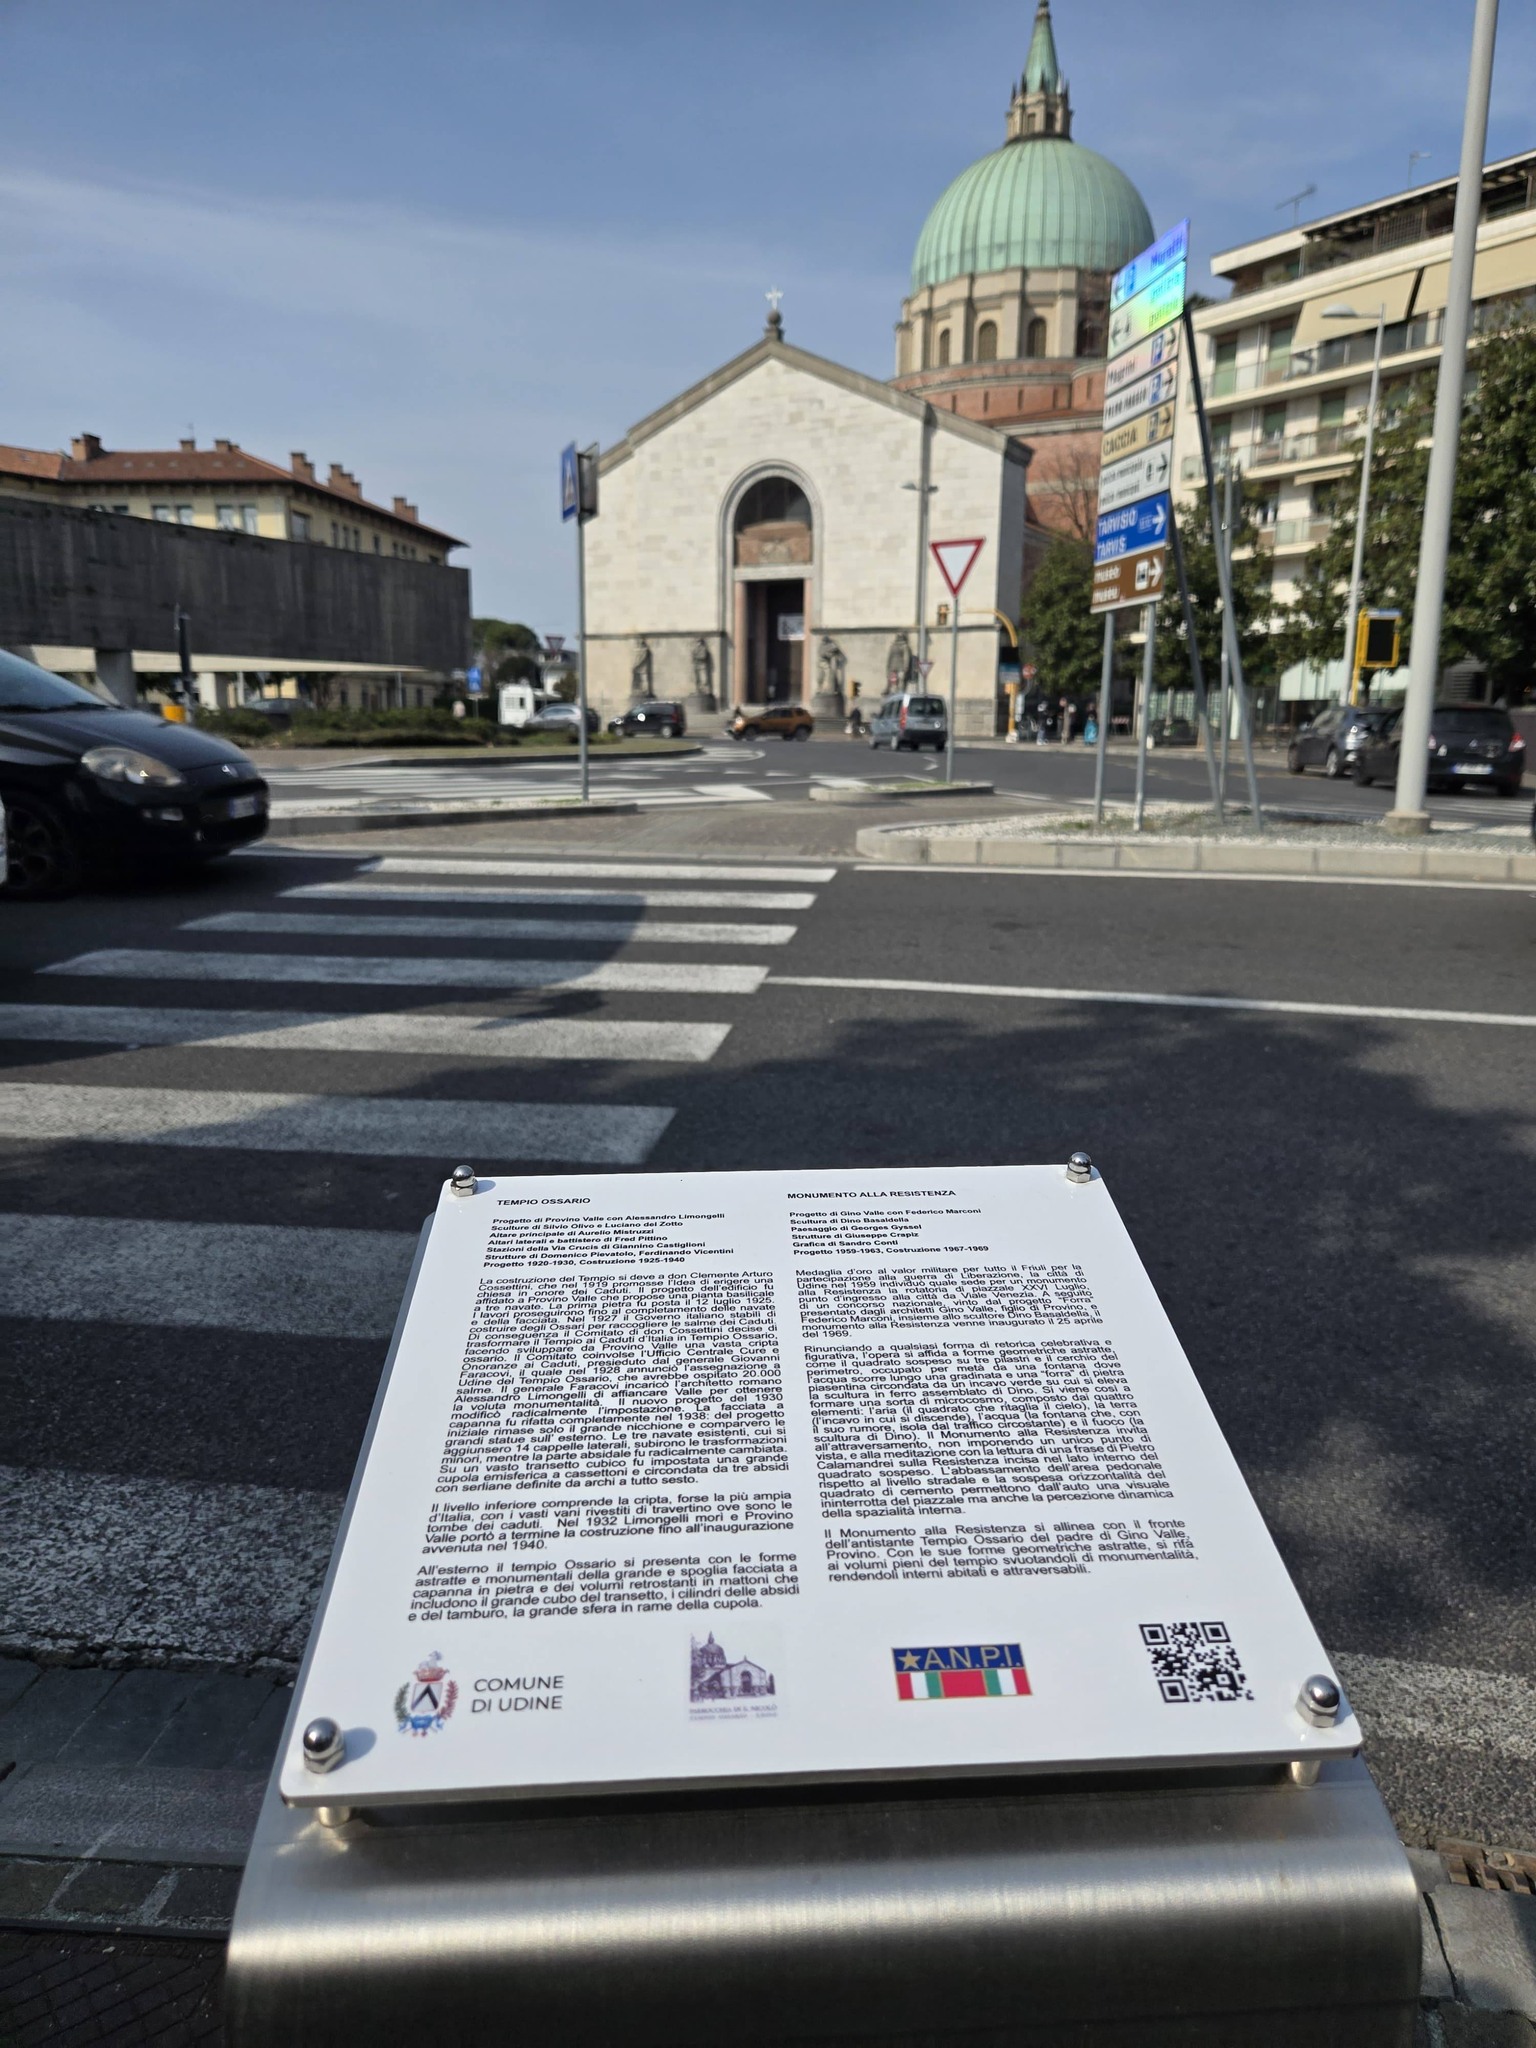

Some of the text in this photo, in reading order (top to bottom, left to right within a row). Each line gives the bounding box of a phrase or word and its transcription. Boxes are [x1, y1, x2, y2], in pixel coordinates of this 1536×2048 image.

[1103, 427, 1137, 456] CACCIA
[1098, 508, 1138, 536] TARVISIO
[1097, 535, 1127, 560] TARVIS
[802, 1329, 852, 1338] del 1969.
[439, 1464, 456, 1473] Su
[485, 1463, 518, 1471] vasto
[526, 1460, 579, 1470] transetto
[586, 1459, 625, 1468] cubico
[632, 1457, 643, 1466] fu
[651, 1456, 709, 1468] impostata
[745, 1453, 788, 1464] grande
[816, 1452, 1158, 1469] Calamandrei sulla Resistenza incisa nel lato interno del
[431, 1490, 791, 1512] Il livello inferiore comprende la cripta, forse la più ampia
[824, 1529, 831, 1538] Il
[839, 1527, 916, 1537] Monumento
[924, 1525, 947, 1535] alla
[955, 1524, 1026, 1534] Resistenza
[1034, 1522, 1045, 1531] si
[1053, 1521, 1095, 1531] allinea
[1133, 1520, 1141, 1528] il
[1147, 1519, 1185, 1528] fronte
[421, 1539, 547, 1553] avvenuta nel 1940.
[416, 1552, 796, 1575] All'esterno il tempio Ossario si presenta con le forme
[827, 1549, 1199, 1571] ai volumi pieni del tempio svuotandoli di monumentalità,
[828, 1569, 898, 1581] rendendoli
[902, 1567, 943, 1579] interni
[947, 1566, 986, 1577] abitati
[1003, 1563, 1091, 1576] attraversabili.
[420, 1609, 442, 1620] del
[446, 1607, 508, 1620] tamburo,
[512, 1606, 524, 1617] la
[529, 1604, 577, 1619] grande
[582, 1603, 616, 1614] sfera
[621, 1602, 632, 1612] in
[637, 1602, 672, 1612] rame
[676, 1599, 709, 1610] della
[713, 1597, 762, 1610] cupola.
[474, 1675, 564, 1692] COMUNE
[471, 1695, 563, 1713] DI UDINE
